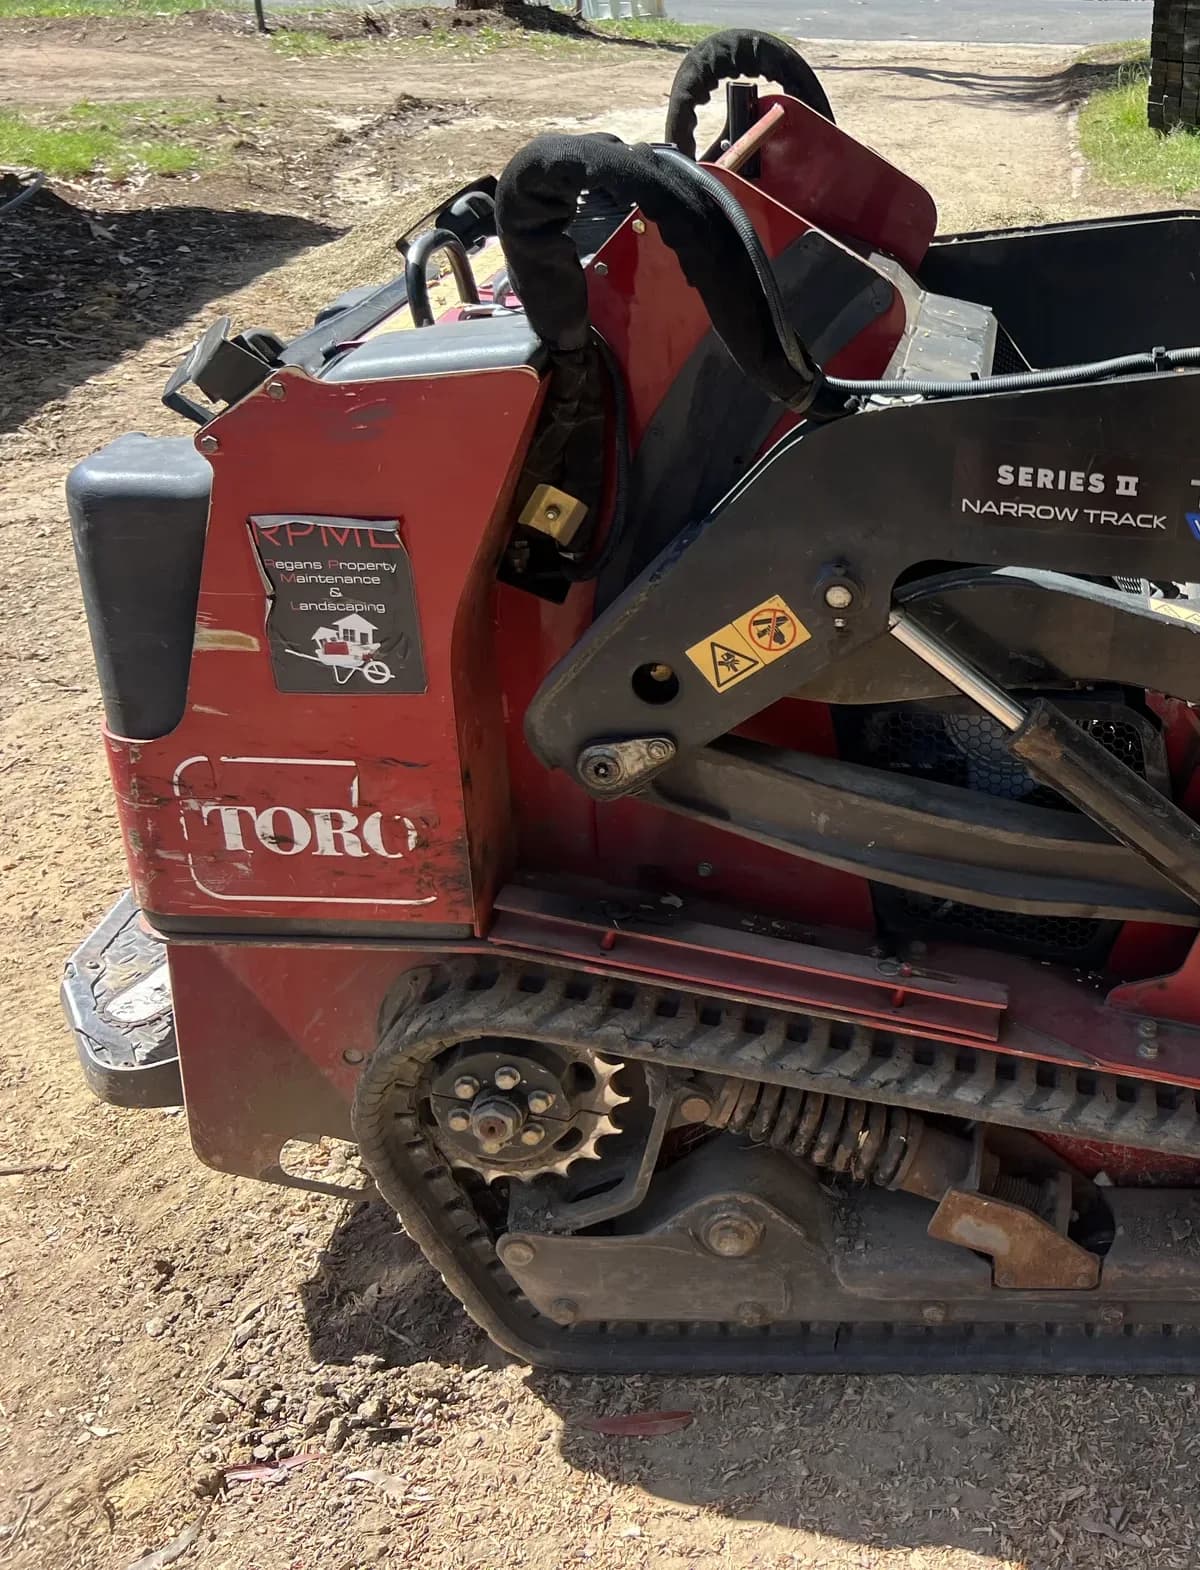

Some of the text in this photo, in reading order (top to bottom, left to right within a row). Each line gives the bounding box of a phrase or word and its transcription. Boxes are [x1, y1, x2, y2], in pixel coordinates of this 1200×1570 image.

[997, 465, 1139, 497] SERIES II
[962, 498, 1168, 530] NARROW TRACK
[264, 559, 398, 574] Regans Property
[280, 573, 381, 585] Maintenance
[329, 587, 343, 598] &
[290, 601, 386, 614] Landscaping
[201, 805, 418, 859] TORO
